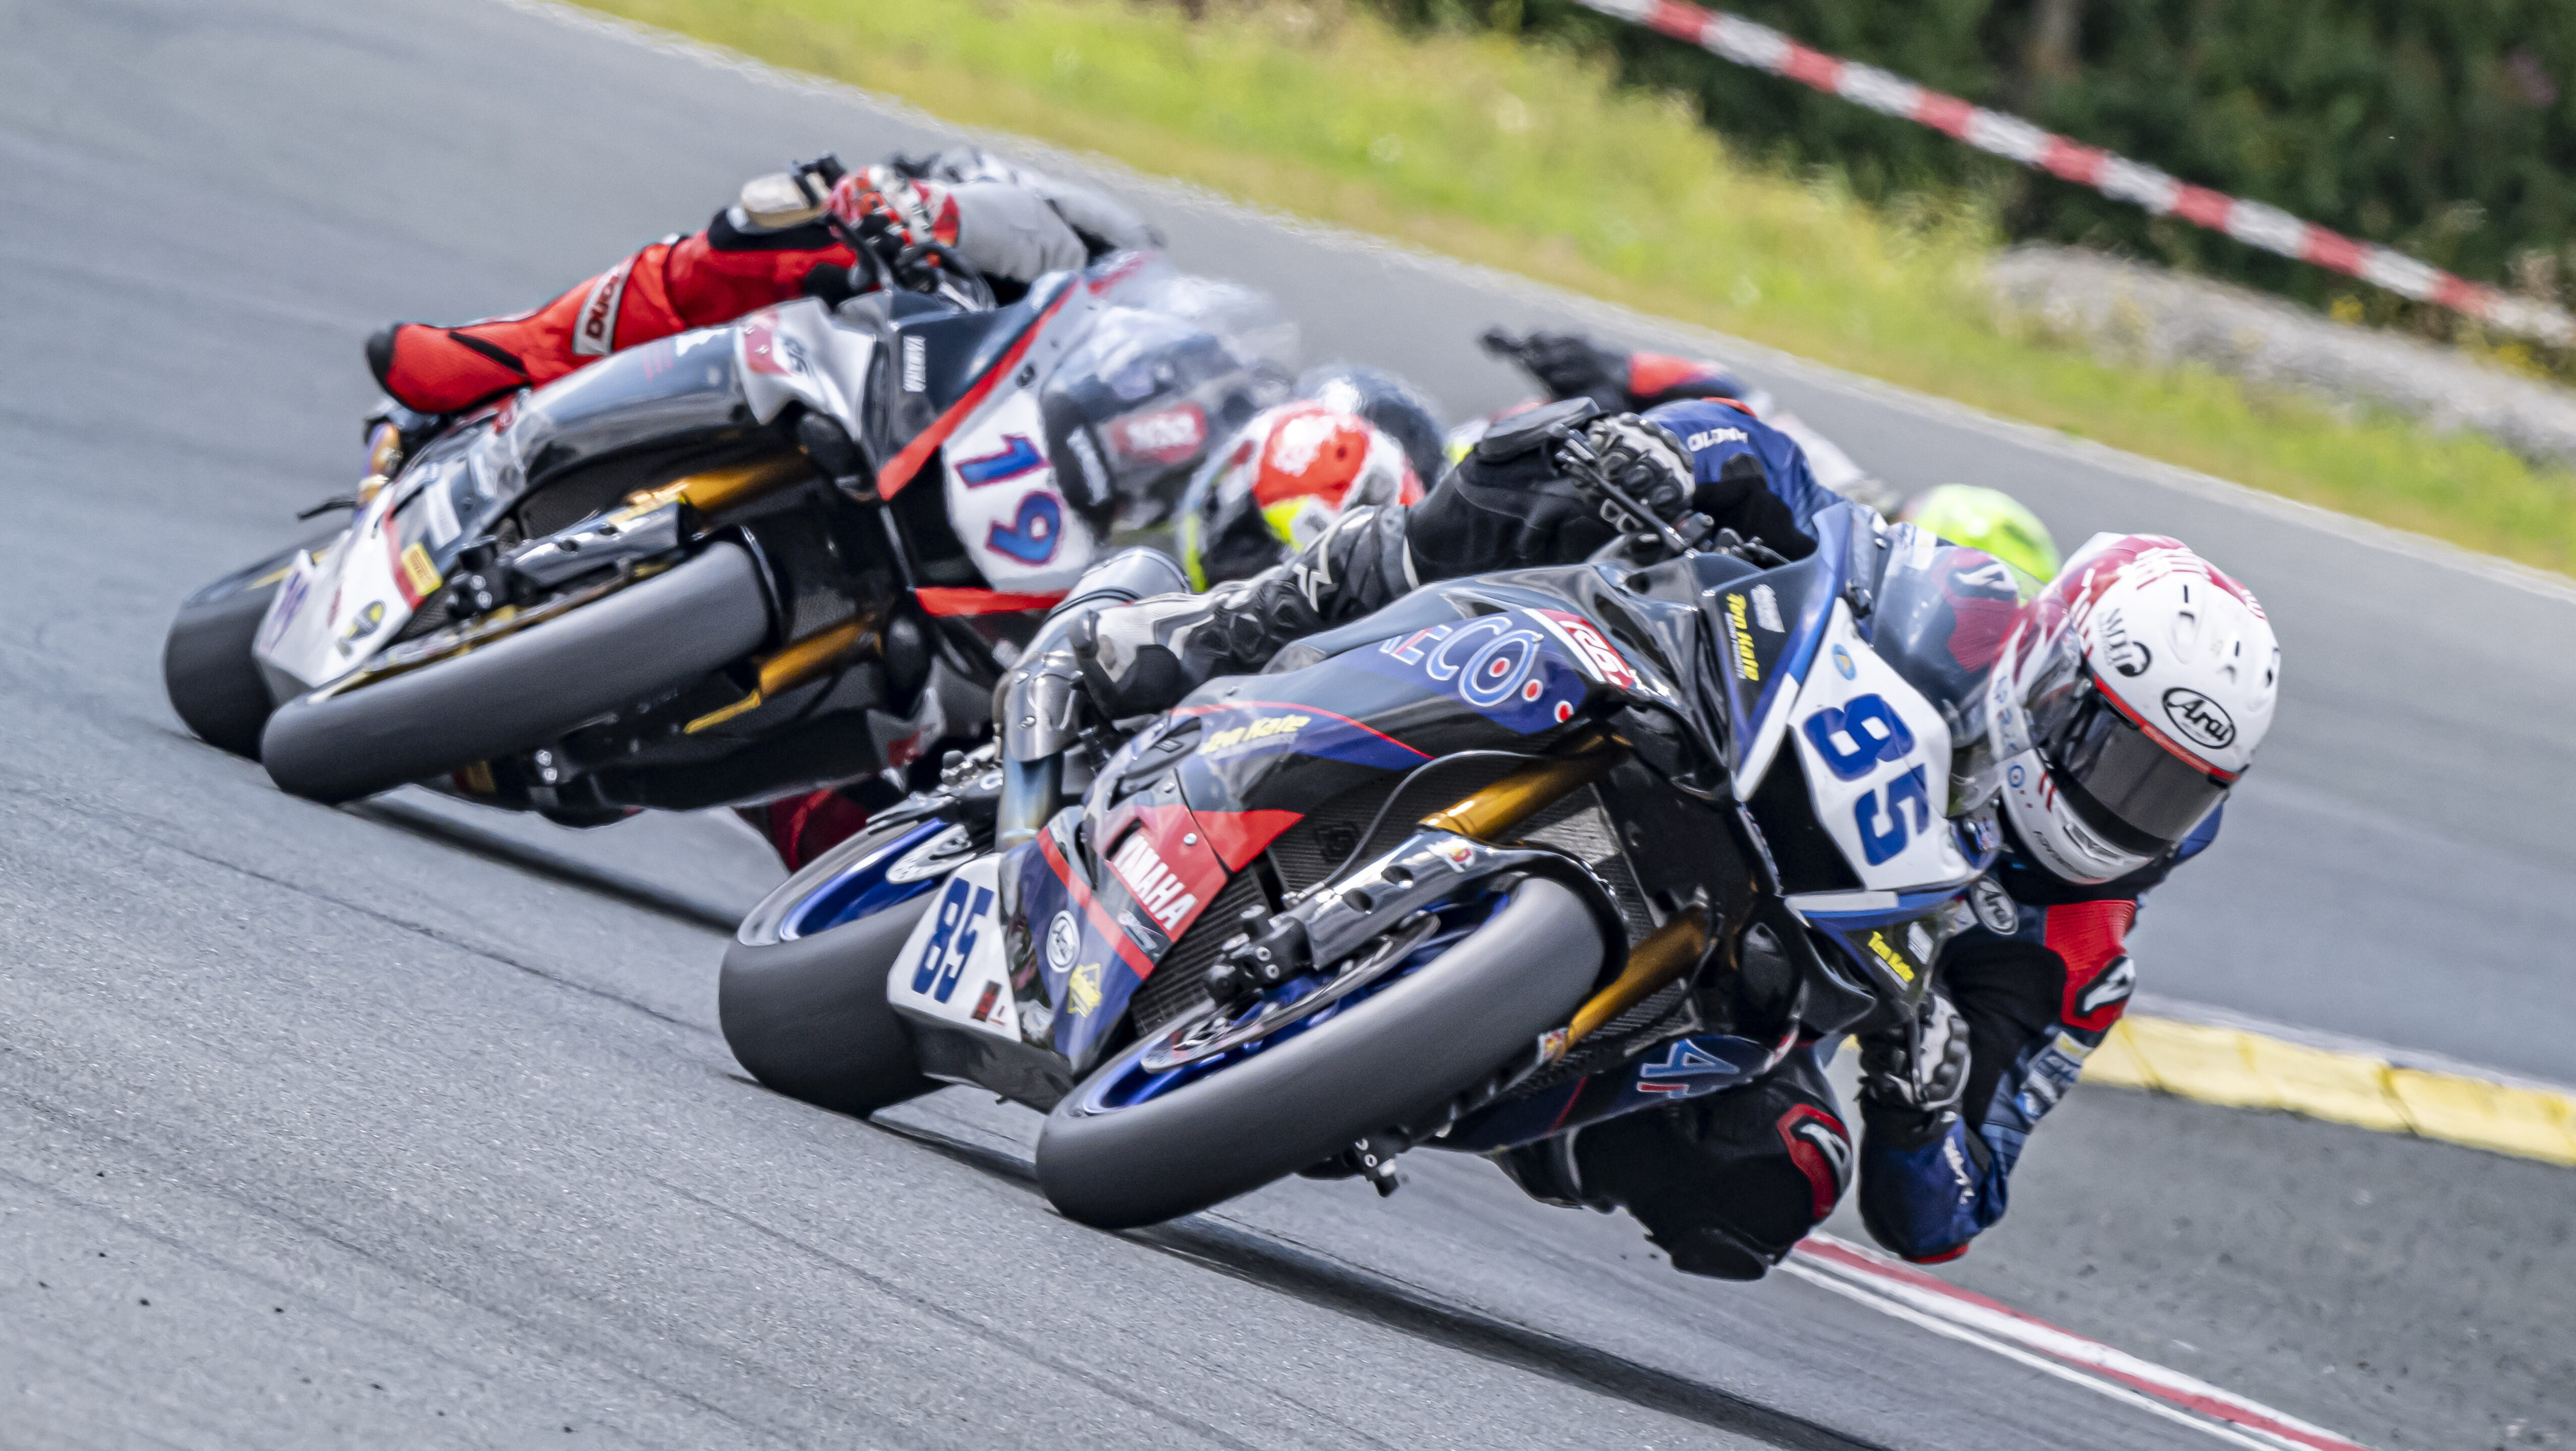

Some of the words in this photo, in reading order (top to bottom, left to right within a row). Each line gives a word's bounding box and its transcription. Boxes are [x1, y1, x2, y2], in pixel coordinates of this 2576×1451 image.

[953, 433, 1062, 567] 19
[2168, 698, 2234, 743] Arai
[1803, 693, 1929, 867] 85
[1111, 833, 1199, 931] YAMAHA
[1980, 888, 2015, 931] Arai
[911, 877, 995, 1003] 85
